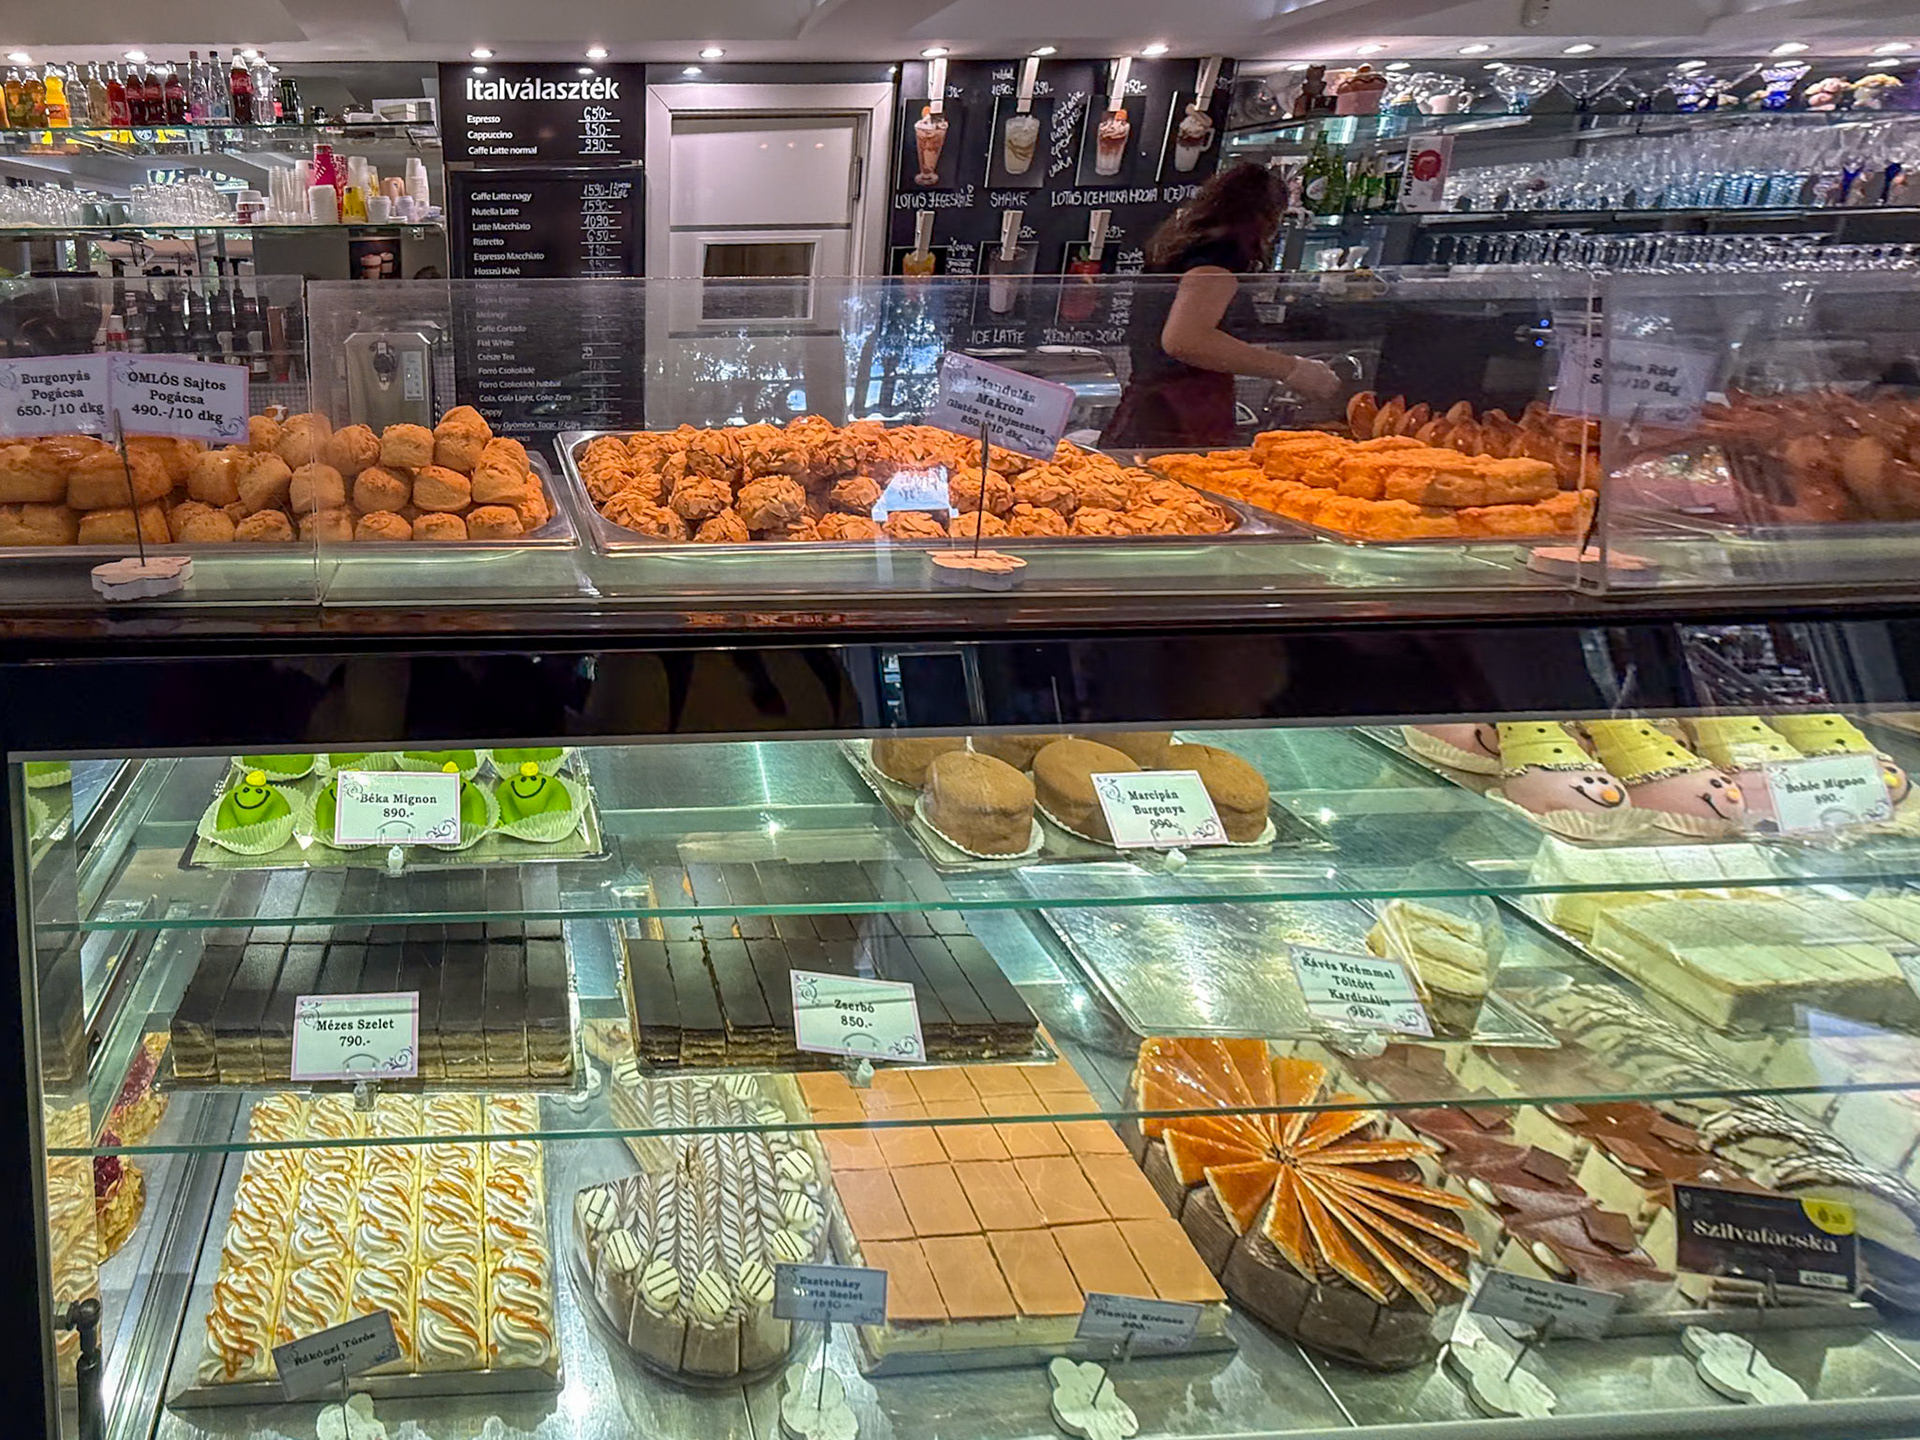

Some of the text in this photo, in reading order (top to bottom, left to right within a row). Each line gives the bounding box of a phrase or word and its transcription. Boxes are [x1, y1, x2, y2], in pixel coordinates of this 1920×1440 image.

[466, 77, 620, 100] Italválaszték
[466, 115, 501, 125] Espresso
[467, 130, 513, 141] Cappuccino
[468, 146, 488, 155] Caffe
[490, 146, 509, 155] Latte
[510, 146, 537, 155] normal
[471, 192, 491, 201] Caffe
[492, 192, 511, 200] Latte
[512, 193, 532, 202] nagy
[895, 192, 927, 209] LOTUS
[990, 191, 1030, 207] SHAKE
[1051, 190, 1099, 208] LOTUS ICE
[1099, 189, 1128, 205] MILKA
[471, 207, 499, 216] Nutella
[500, 207, 519, 216] Latte
[472, 223, 491, 231] Latte
[492, 222, 531, 231] Macchiato
[473, 238, 504, 246] Ristretto
[473, 252, 506, 262] Espresso
[506, 252, 545, 260] Macchiato
[474, 267, 500, 275] Hosszú
[501, 266, 520, 275] Kávé
[497, 325, 527, 333] Cortado
[993, 328, 1026, 344] LATTE
[477, 339, 515, 347] Flat White
[477, 353, 501, 361] Csésze
[498, 366, 535, 374] Csokoládé
[21, 370, 91, 386] Burgonyás
[183, 376, 227, 392] Sajtos
[499, 380, 535, 388] Csokoládé
[31, 388, 85, 402] Pogácsa
[976, 375, 1036, 403] Mandulás
[149, 389, 205, 405] Pogácsa
[535, 394, 554, 402] Coke
[16, 400, 105, 417] 650.-/10 dkg
[975, 392, 1025, 416] Makron
[131, 404, 223, 425] 490.-/10 dkg
[480, 408, 503, 417] Cappy
[985, 410, 996, 420] és
[997, 412, 1046, 435] tejmentes
[1005, 428, 1024, 442] dkg
[1823, 777, 1867, 789] Mignon
[359, 793, 437, 806] Béka Mignon
[1127, 789, 1179, 802] Marcipán
[383, 808, 414, 818] 890.-
[1132, 805, 1186, 816] Burgonya
[1302, 953, 1395, 980] Kávés Krémmel
[1331, 975, 1376, 991] Töltött
[1328, 988, 1391, 1007] Kardinális
[834, 999, 875, 1013] Zserbó
[316, 1019, 394, 1031] Mézes Szelet
[840, 1015, 873, 1028] 850.-
[339, 1036, 371, 1047] 790.-
[799, 1276, 861, 1290] Eszterházy
[829, 1289, 863, 1301] Szelet
[294, 1331, 376, 1367] Rákóczi Túrós
